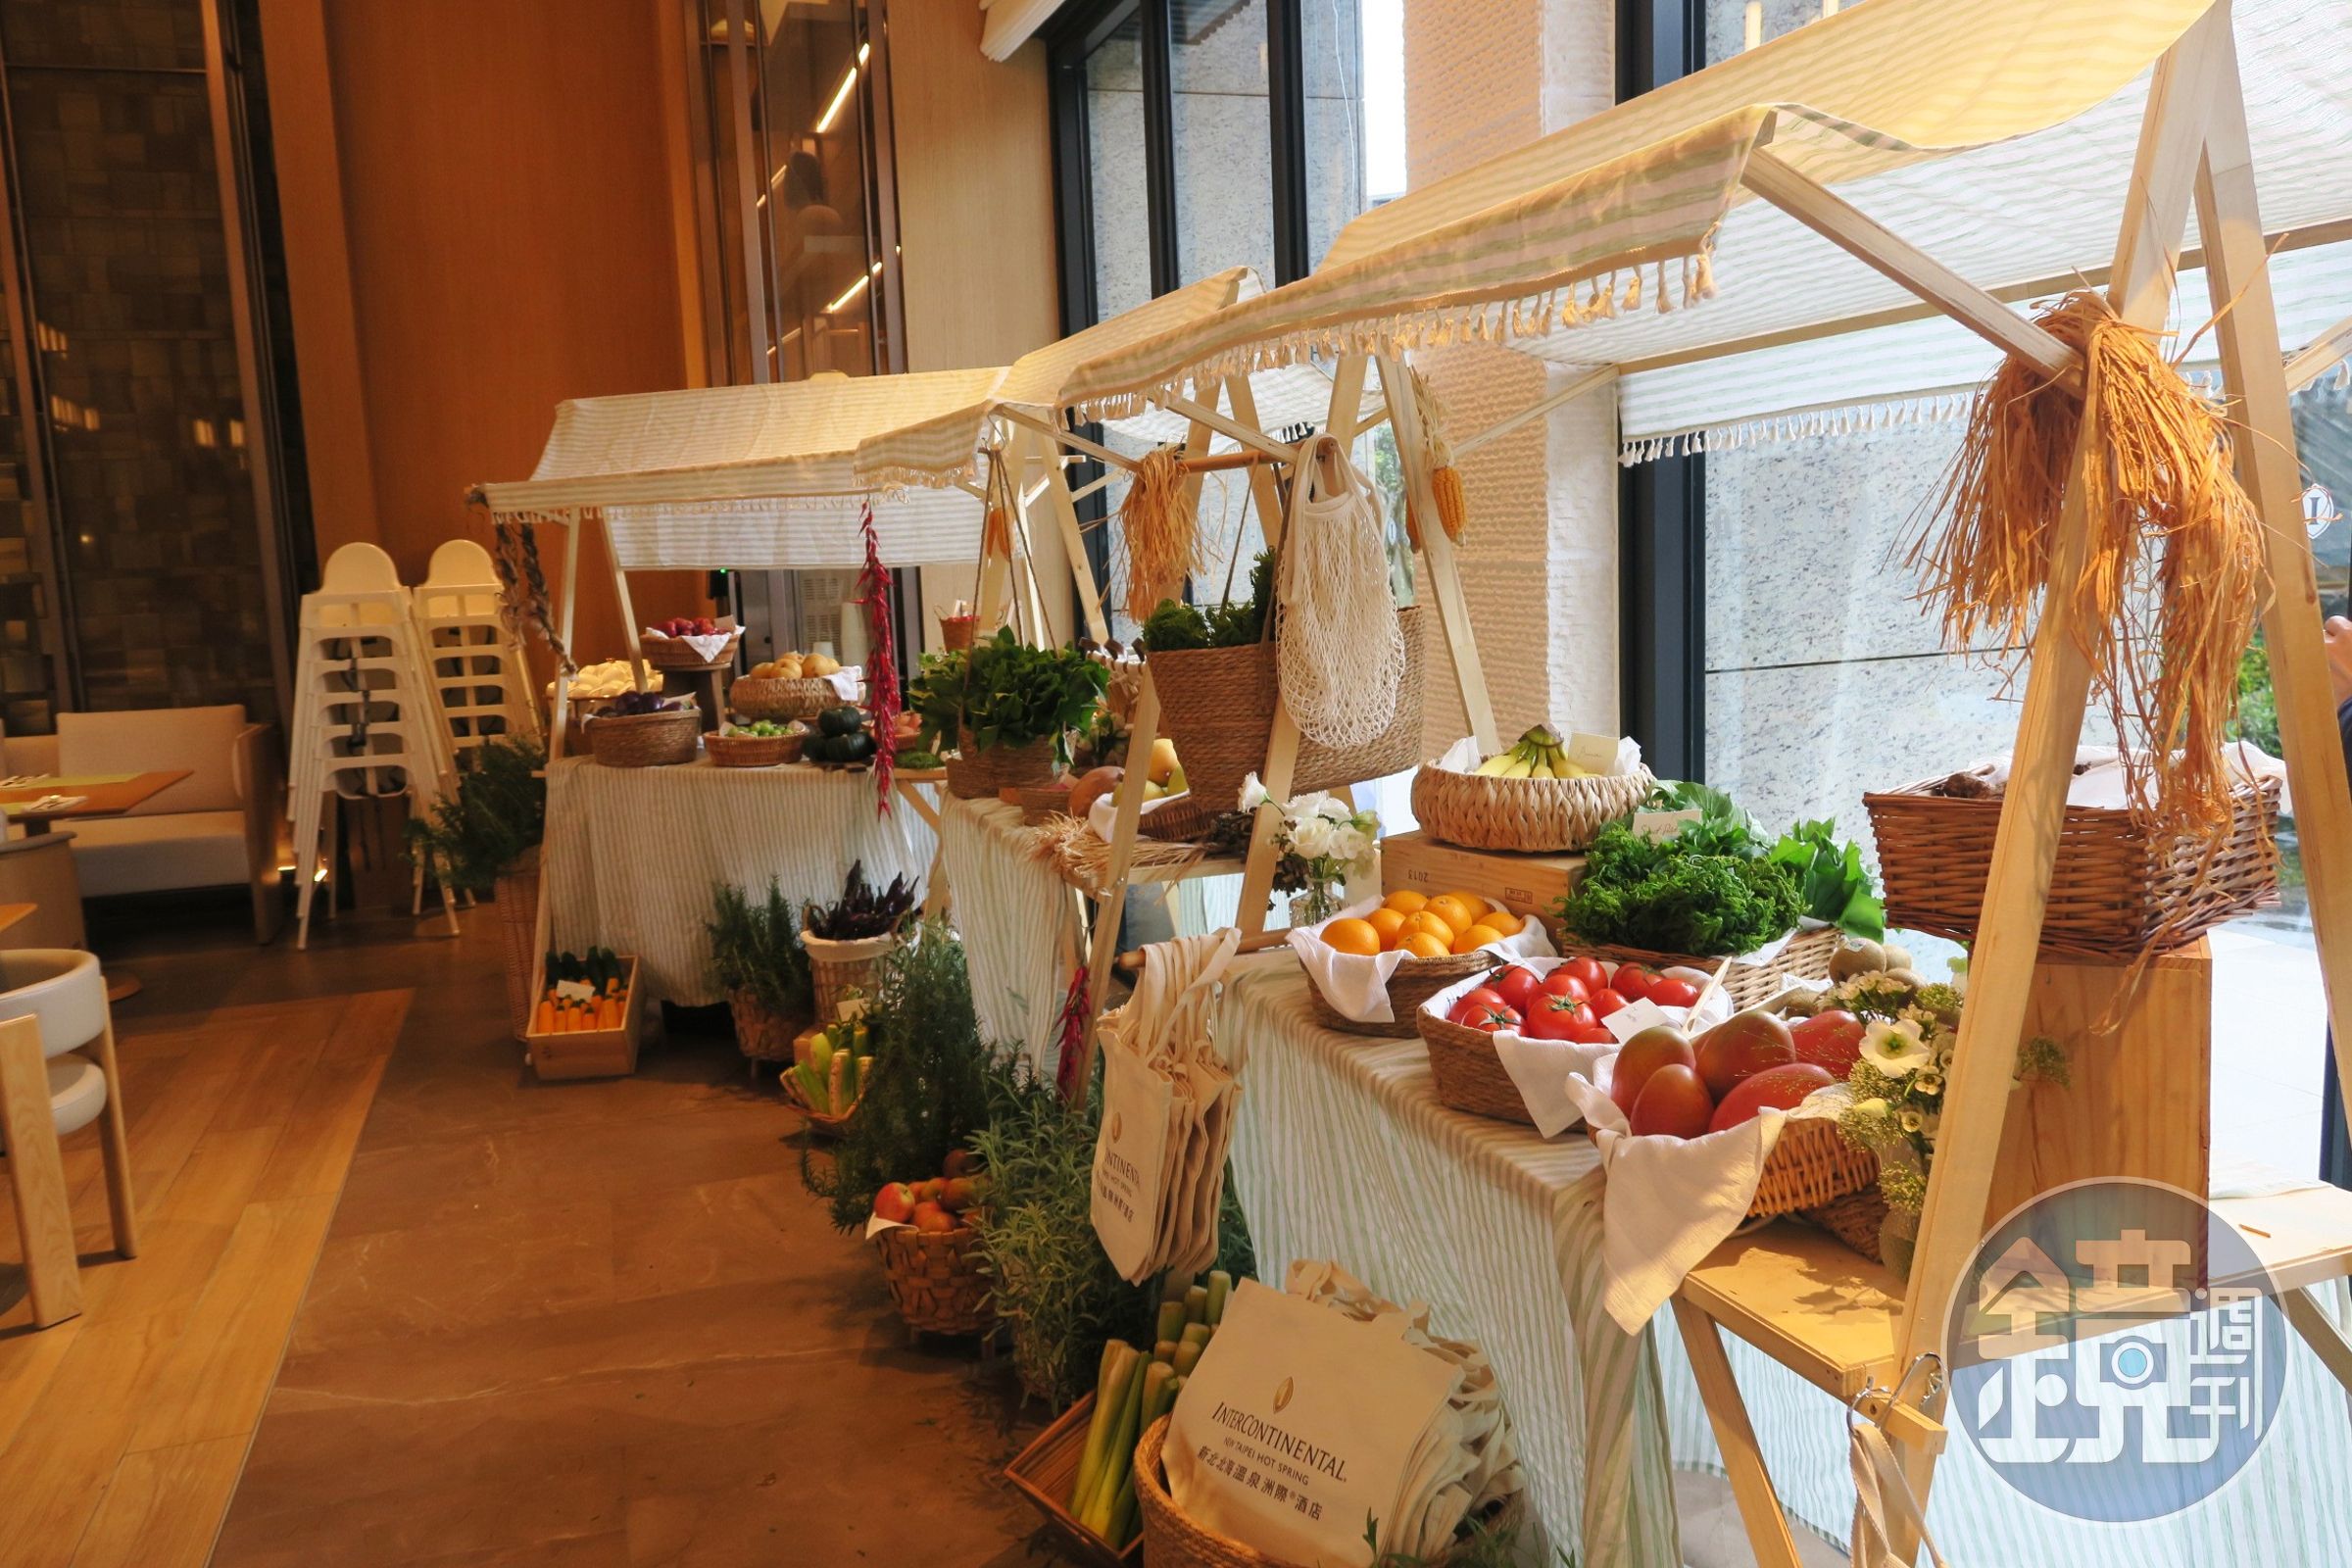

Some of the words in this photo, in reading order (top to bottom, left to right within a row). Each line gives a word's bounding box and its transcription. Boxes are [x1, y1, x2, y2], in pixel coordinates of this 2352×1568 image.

[1407, 869, 1429, 883] 2013
[1236, 1441, 1255, 1459] TAIPEI
[1256, 1451, 1276, 1469] HOT
[1277, 1461, 1309, 1487] SPRING
